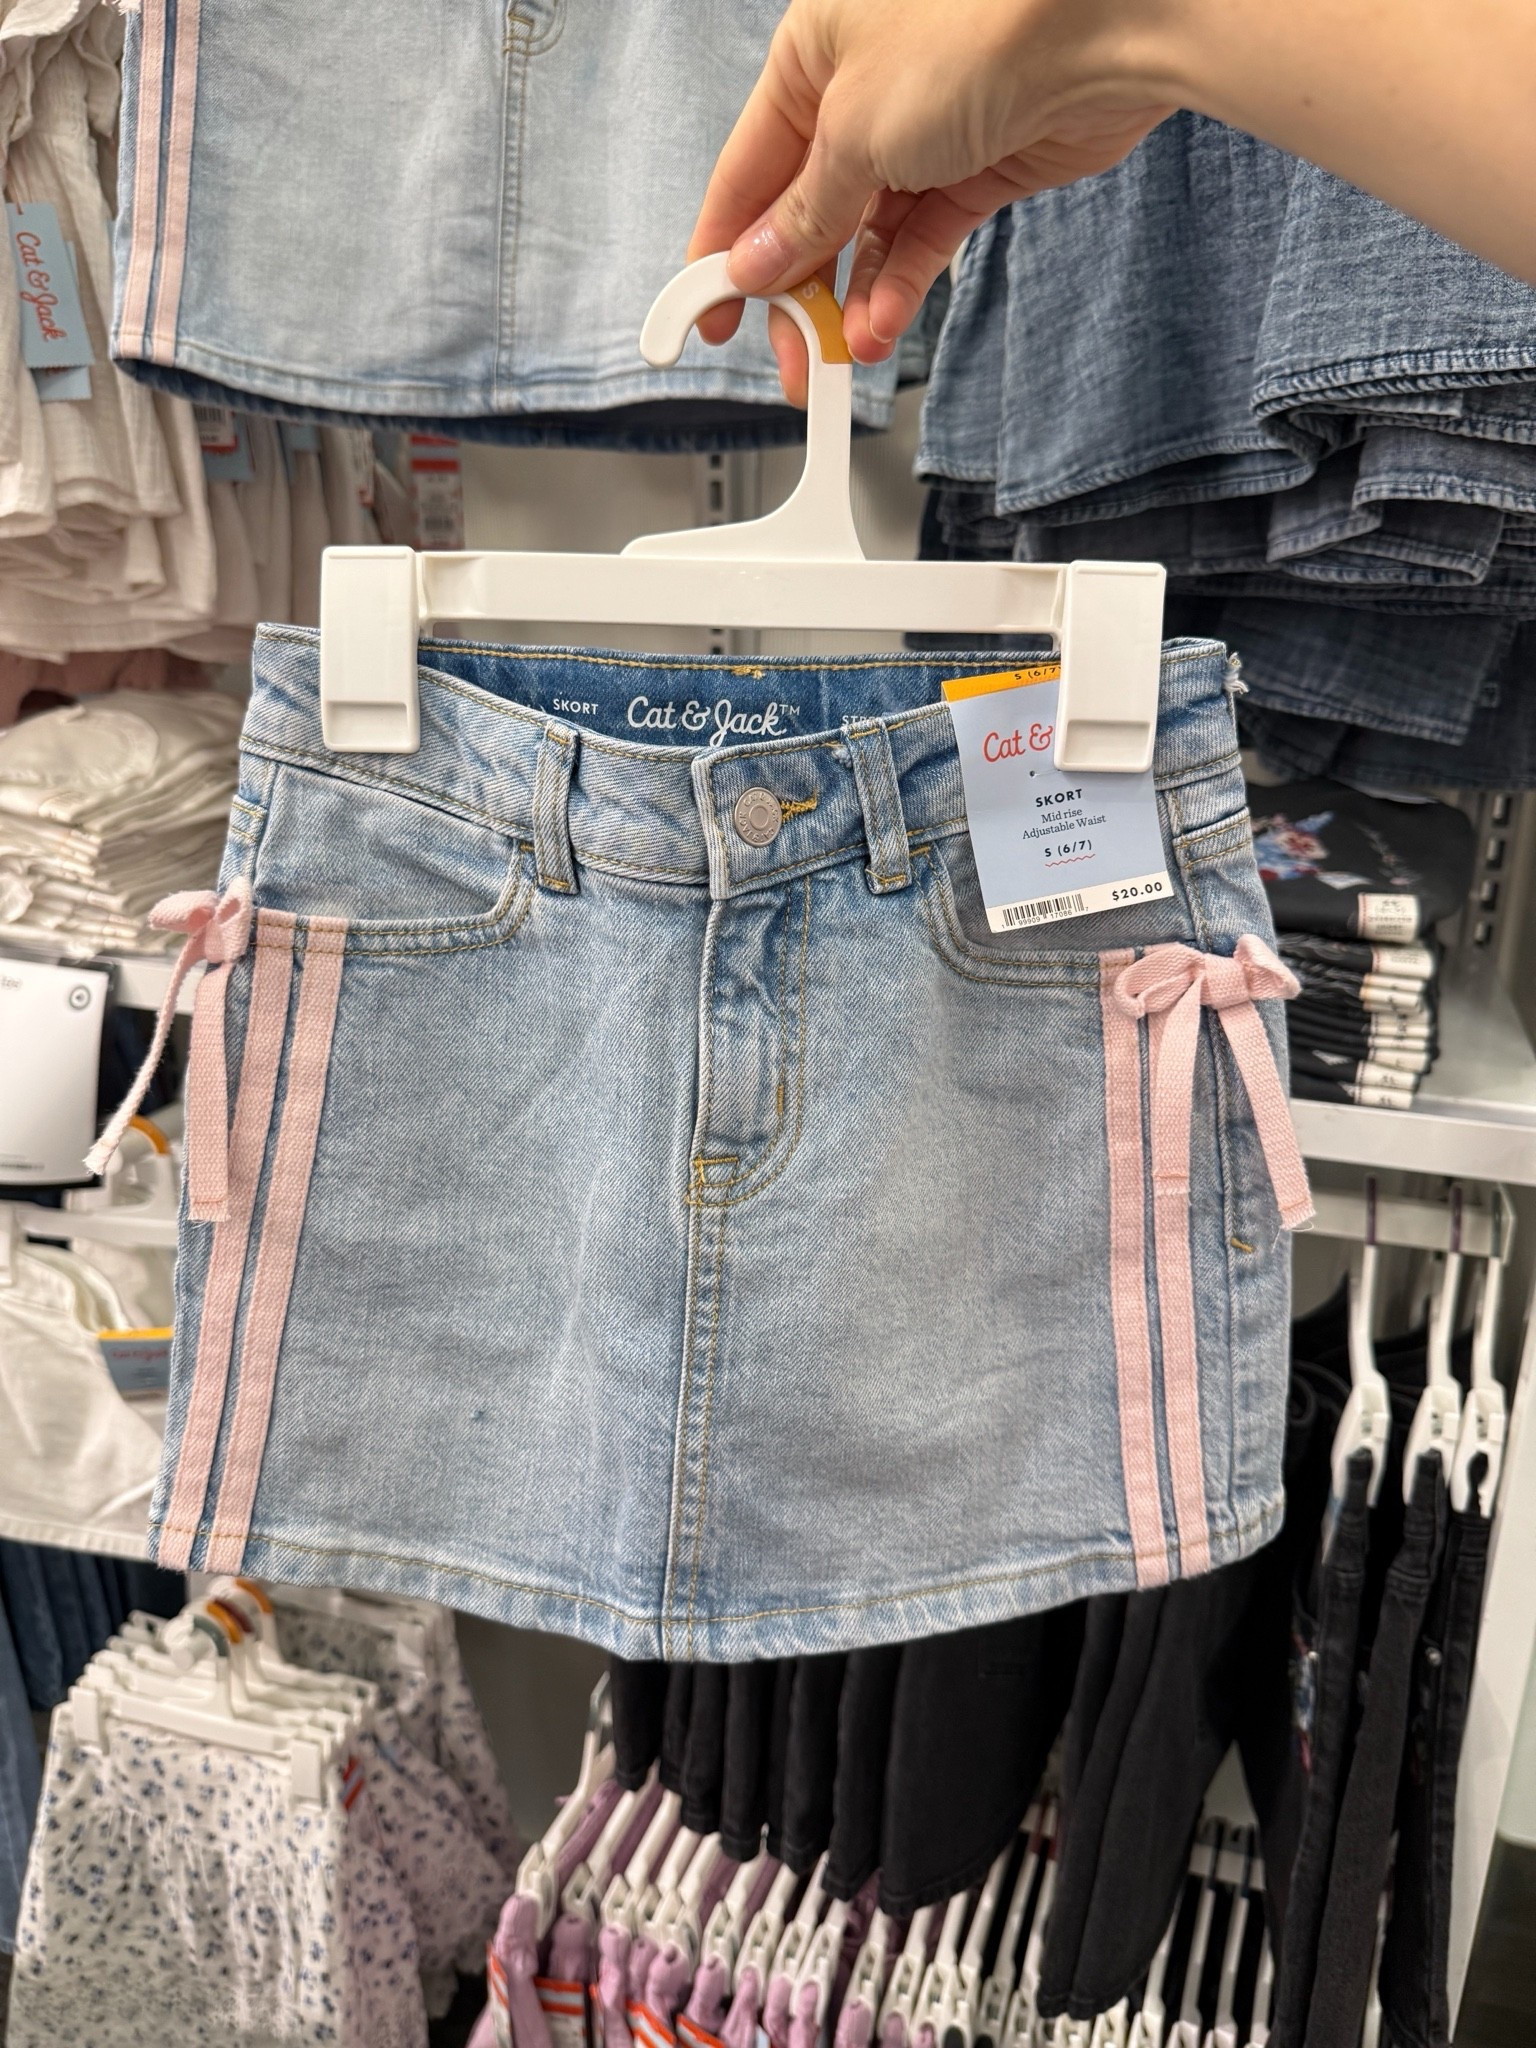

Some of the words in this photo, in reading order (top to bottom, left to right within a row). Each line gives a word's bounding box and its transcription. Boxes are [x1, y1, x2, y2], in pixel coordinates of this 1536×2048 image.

[16, 231, 45, 267] Cat
[27, 269, 50, 291] &
[20, 291, 67, 342] Jack
[553, 698, 599, 715] SKORT
[627, 695, 677, 729] Cat
[682, 700, 711, 731] &
[983, 729, 1026, 763] Cat
[1028, 723, 1054, 751] &
[1035, 788, 1083, 808] SKORT
[1022, 820, 1075, 839] Adjustable
[1075, 814, 1107, 828] Waist
[1041, 810, 1062, 824] Mid
[1063, 808, 1083, 819] rise
[1044, 847, 1052, 857] S
[1057, 839, 1092, 857] (6/7)
[1112, 881, 1163, 901] $20.00
